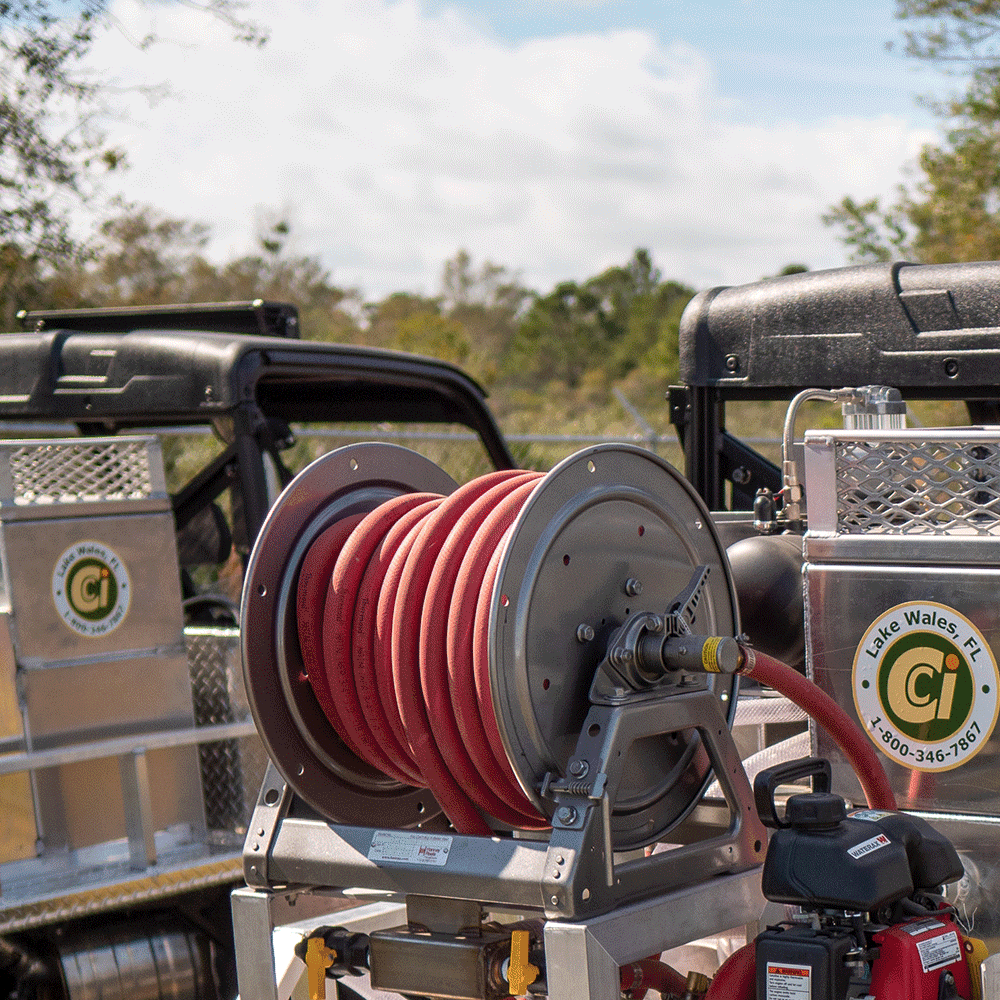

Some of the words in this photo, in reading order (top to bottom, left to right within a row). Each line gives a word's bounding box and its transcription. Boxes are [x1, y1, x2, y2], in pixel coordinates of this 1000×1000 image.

[865, 620, 901, 659] Lake
[903, 609, 960, 640] Wales,
[963, 636, 982, 662] FL
[870, 716, 982, 764] 1-800-346-7867
[851, 840, 881, 857] WATERAX
